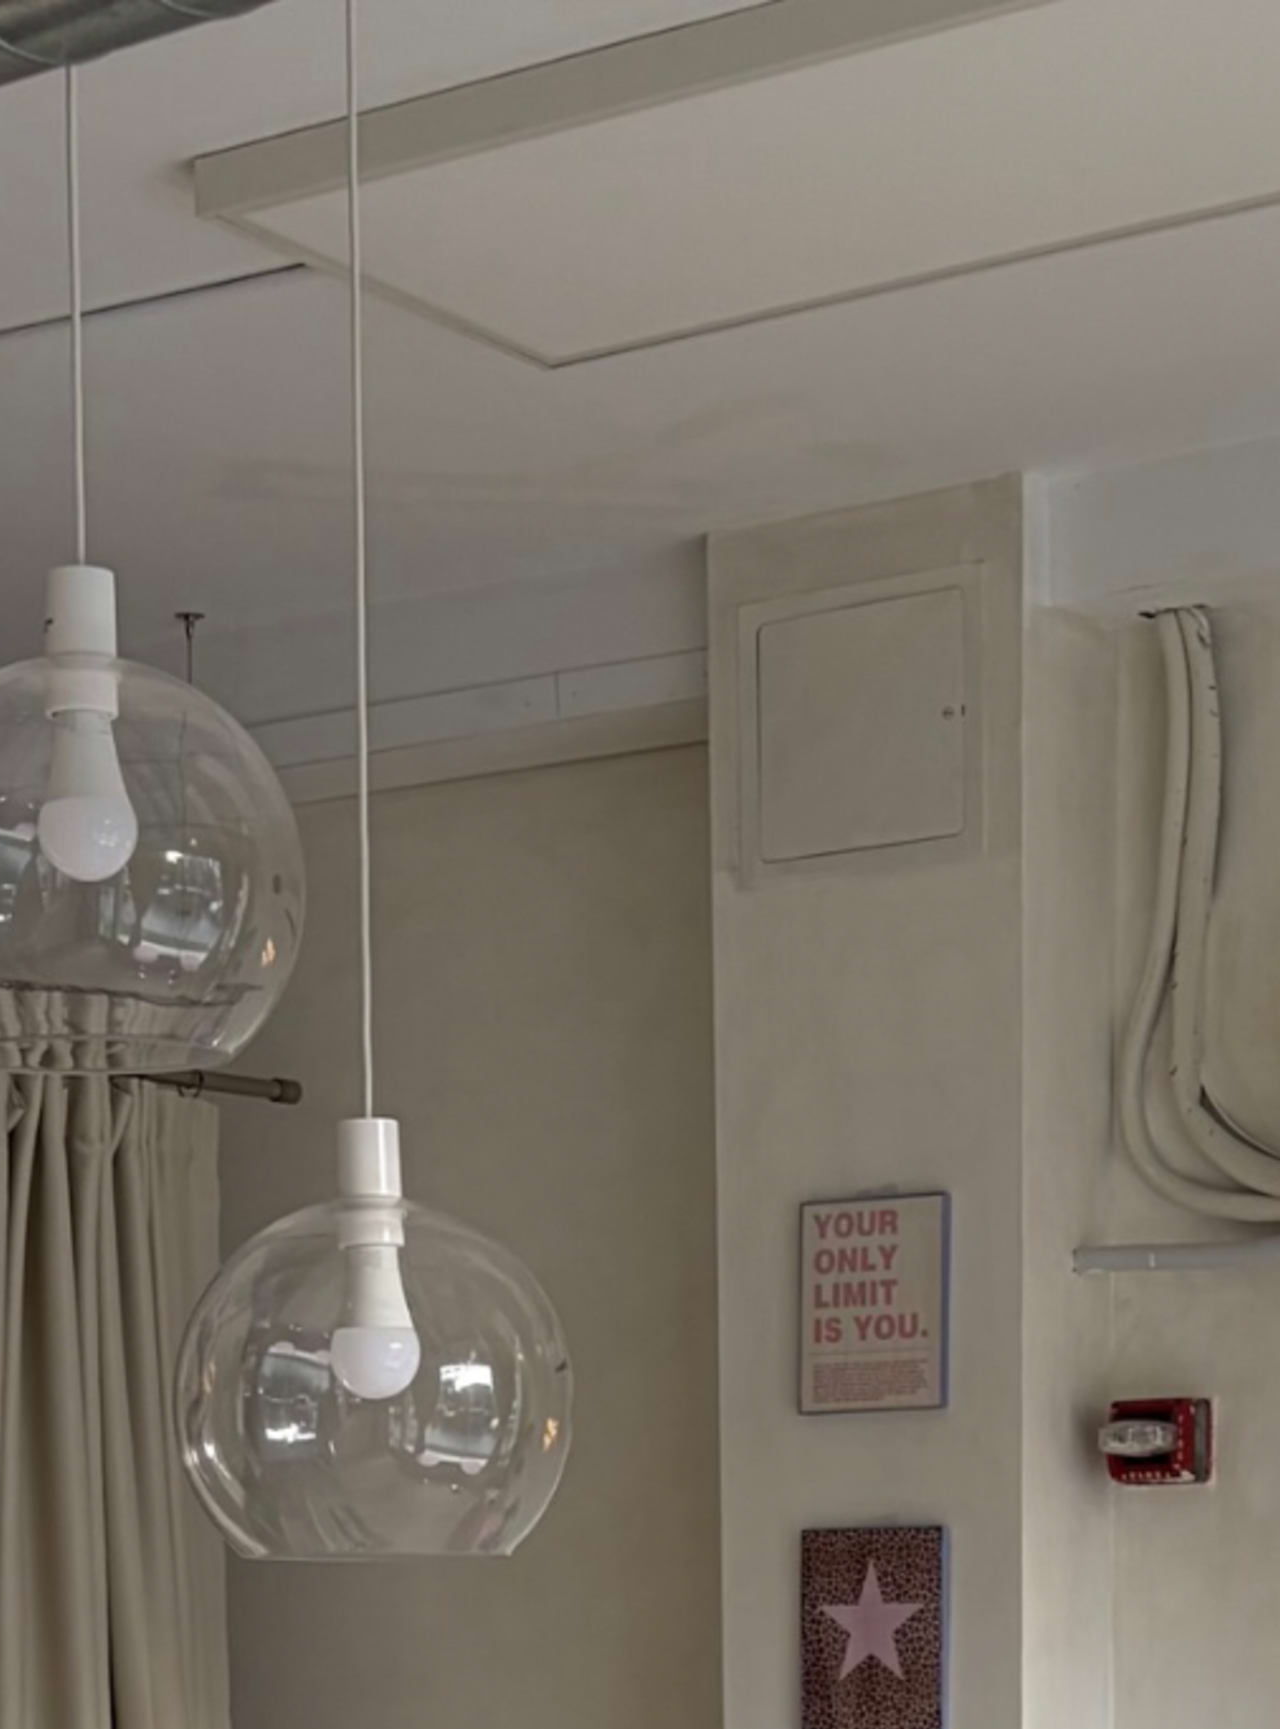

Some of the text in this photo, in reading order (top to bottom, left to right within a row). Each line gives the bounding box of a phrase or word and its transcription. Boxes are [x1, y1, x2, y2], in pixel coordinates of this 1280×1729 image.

[813, 1209, 899, 1239] YOUR
[813, 1245, 898, 1275] ONLY
[814, 1279, 898, 1309] LIMIT
[814, 1313, 928, 1344] IS YOU.
